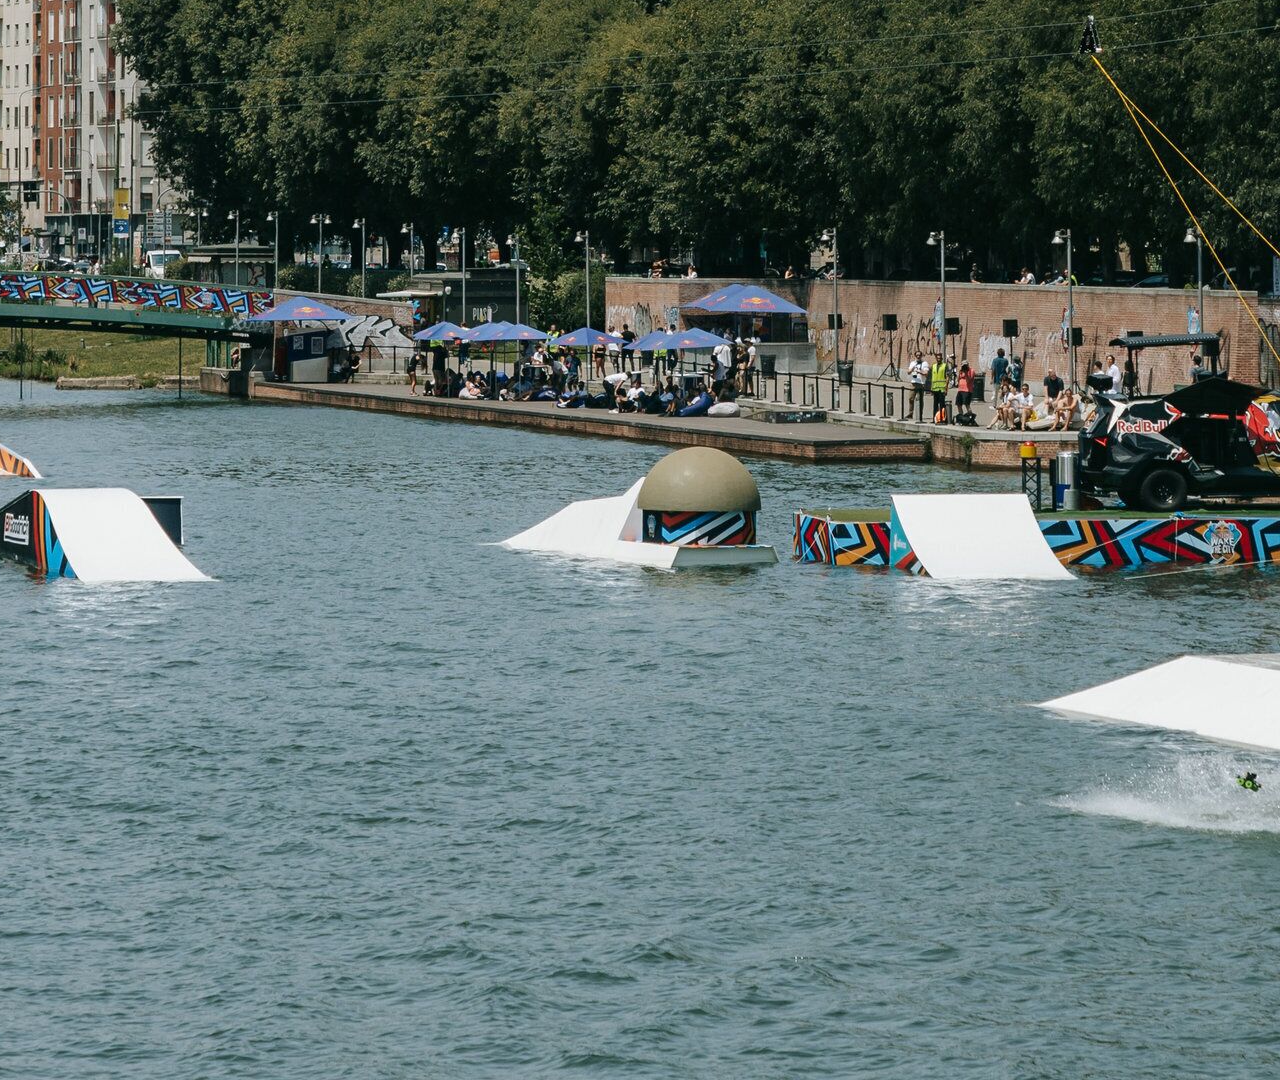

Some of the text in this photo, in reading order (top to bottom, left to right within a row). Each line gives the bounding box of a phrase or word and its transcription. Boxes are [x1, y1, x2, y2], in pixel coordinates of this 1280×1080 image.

[1117, 421, 1168, 433] Red Bull
[1211, 537, 1235, 546] WAKE
